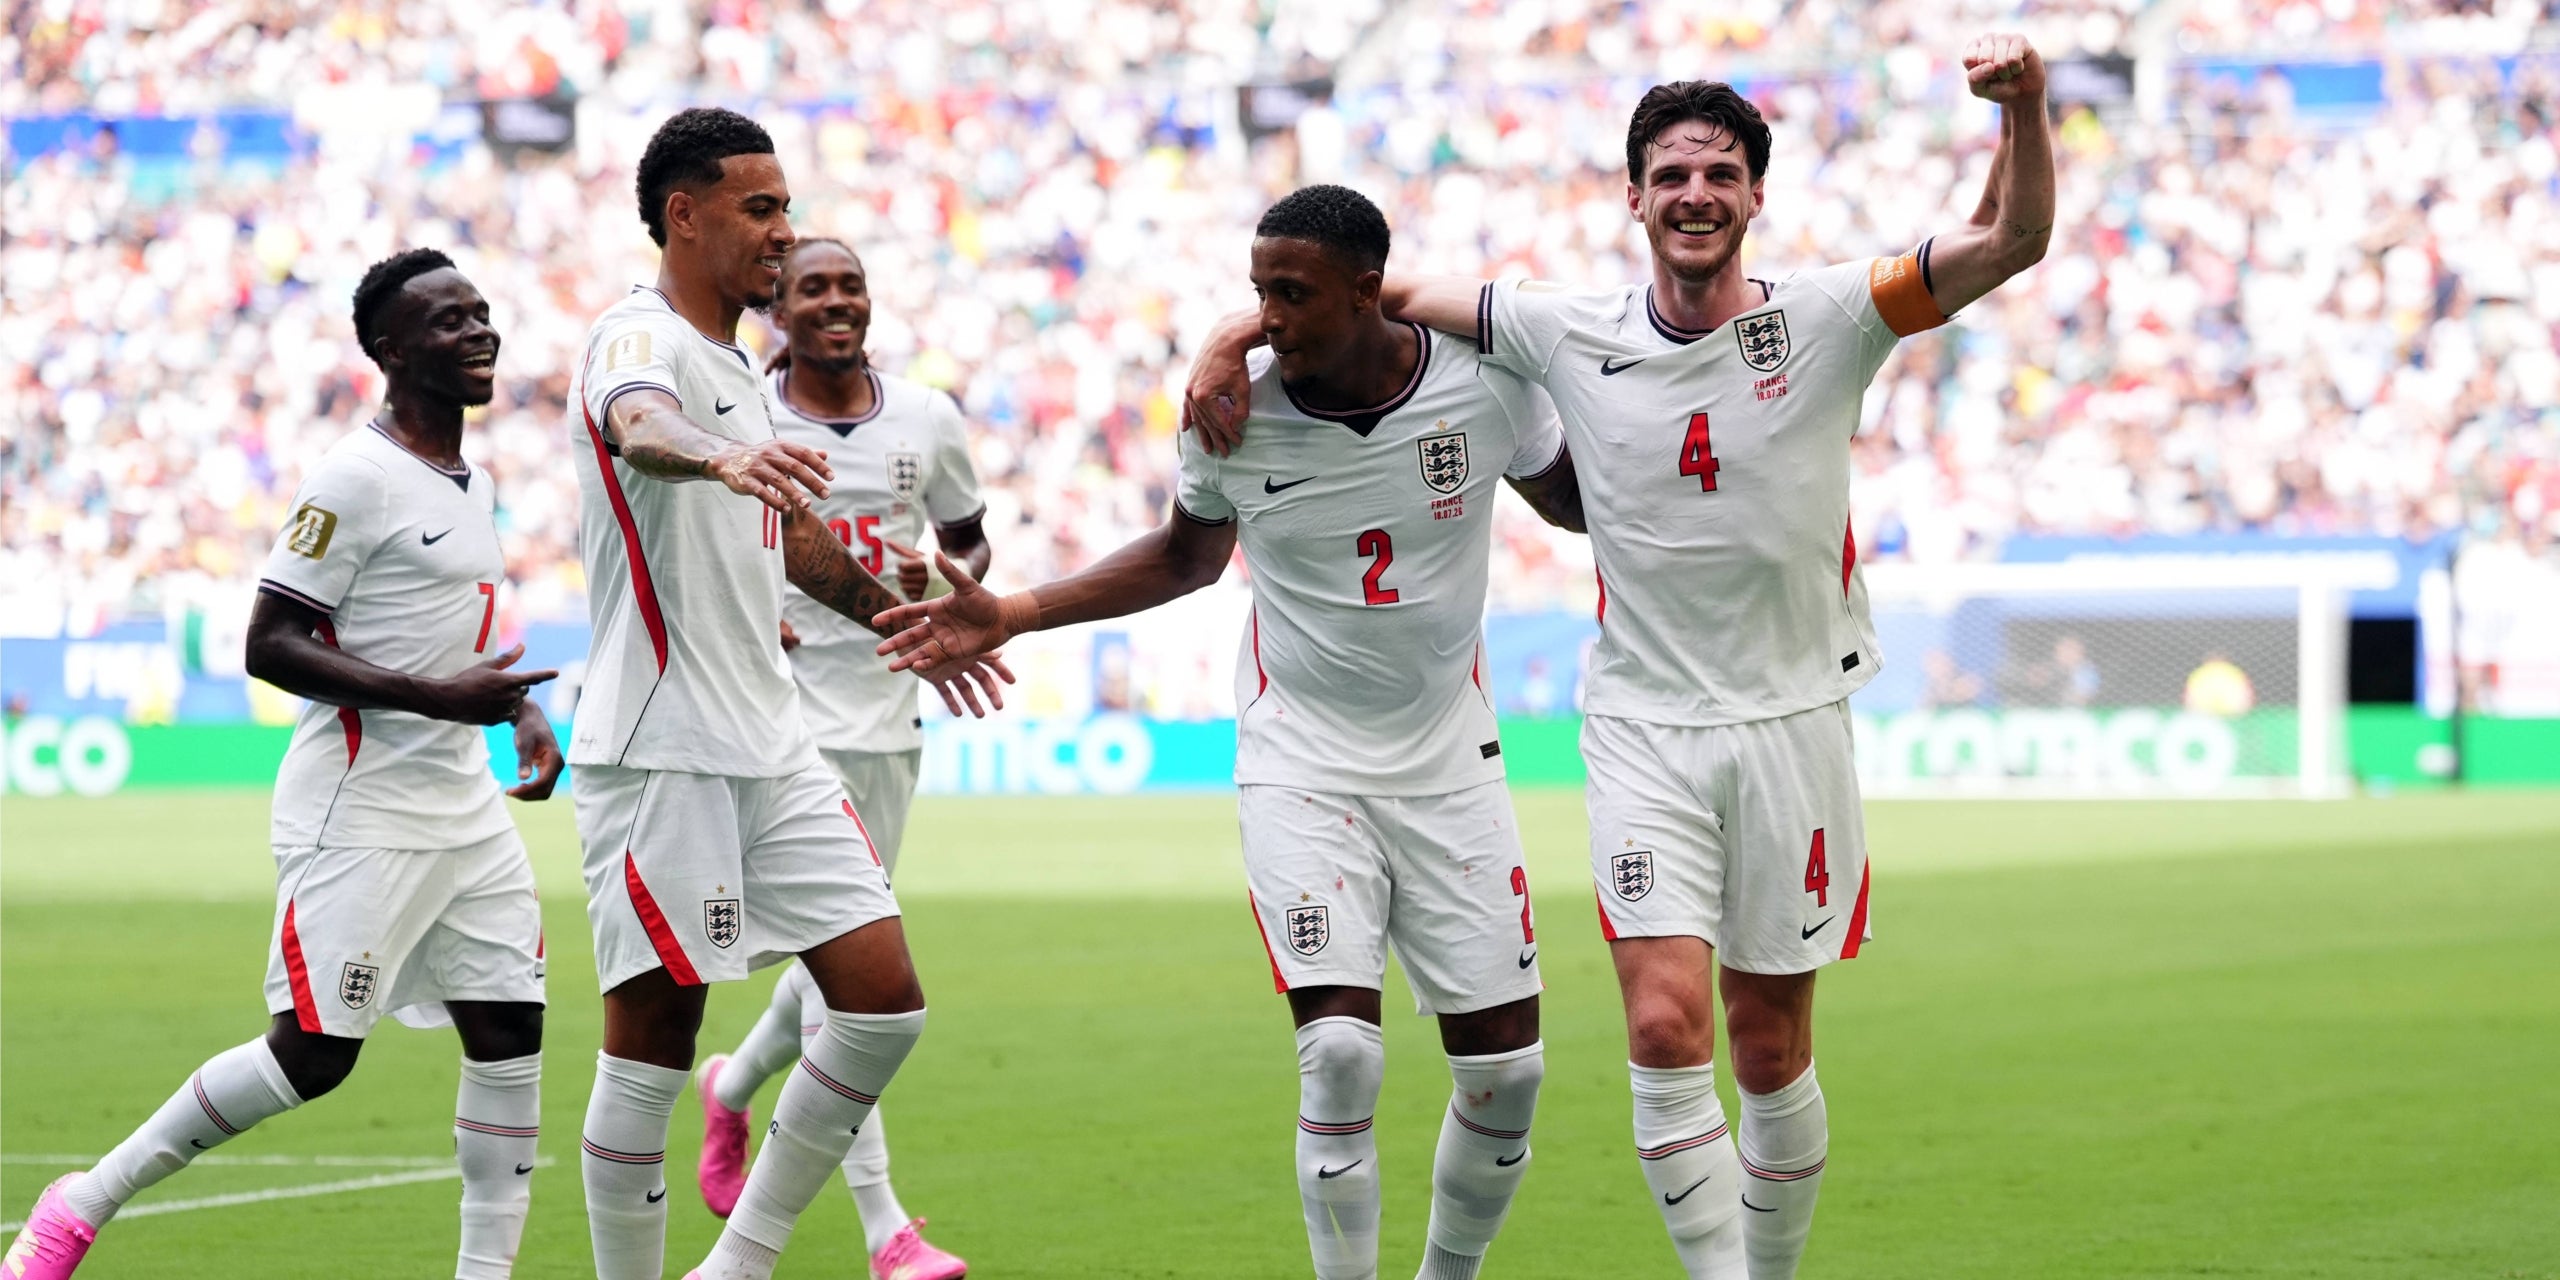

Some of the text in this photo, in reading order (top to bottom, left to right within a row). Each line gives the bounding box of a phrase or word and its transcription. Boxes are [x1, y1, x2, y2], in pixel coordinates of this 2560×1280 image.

[1754, 374, 1788, 390] FRANCE
[1756, 386, 1787, 401] 18.07.26
[1679, 412, 1721, 493] 4
[1431, 495, 1463, 510] FRANCE
[1433, 507, 1463, 521] 18.07.26
[1357, 528, 1400, 606] 2
[474, 581, 495, 654] 7
[0, 713, 134, 797] co
[918, 711, 1153, 793] mco
[1510, 865, 1535, 945] 2
[1804, 827, 1830, 909] 4
